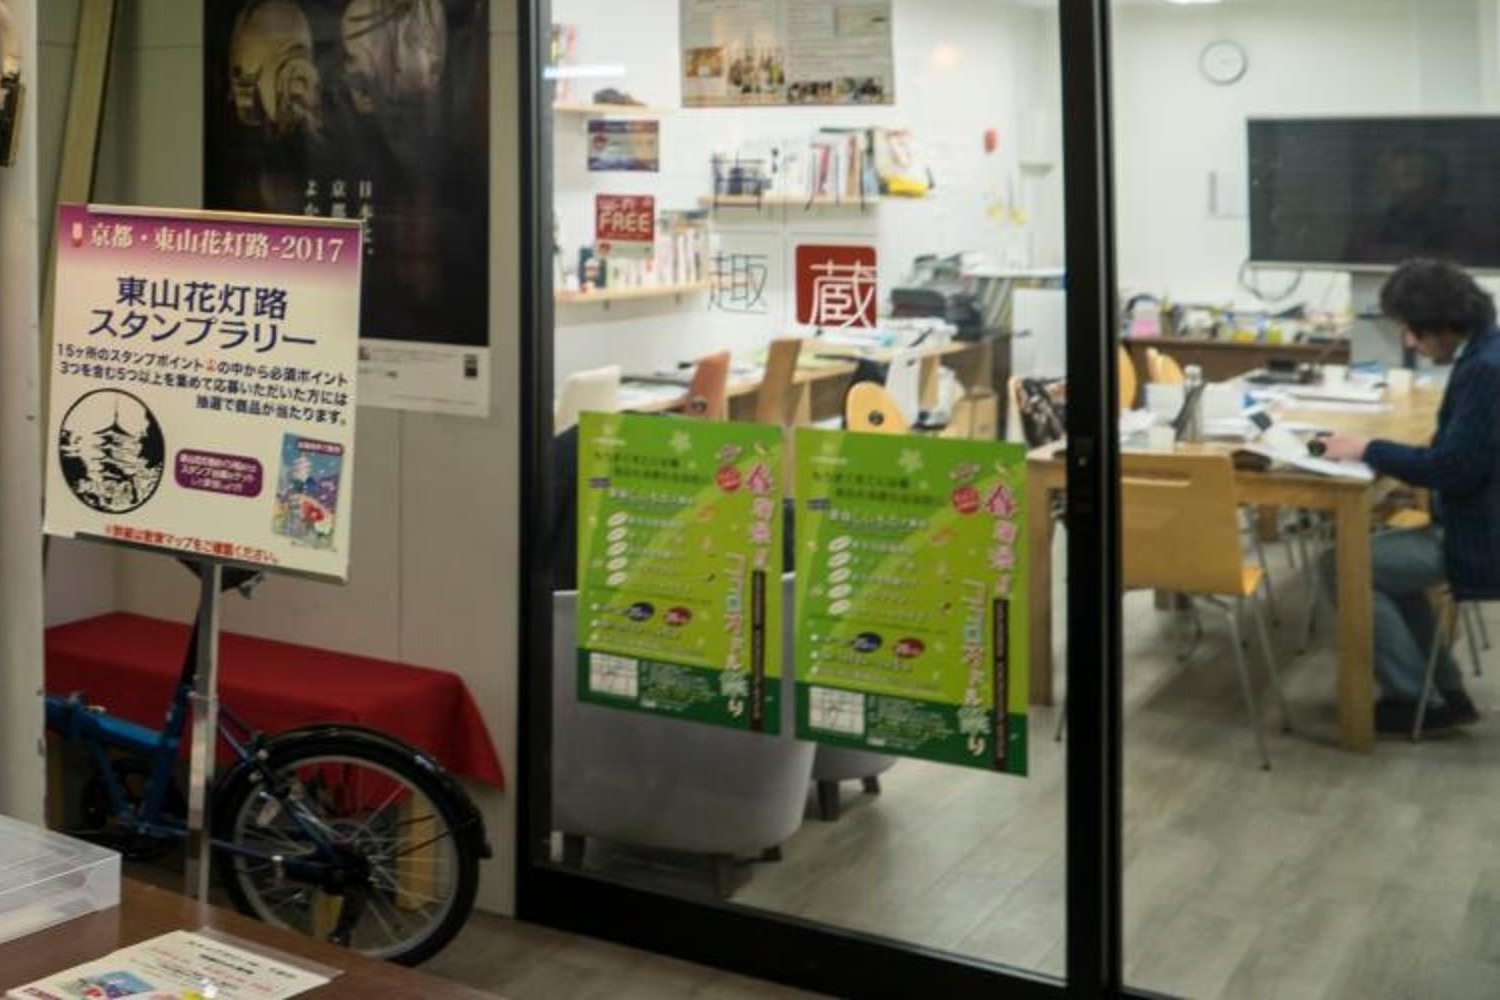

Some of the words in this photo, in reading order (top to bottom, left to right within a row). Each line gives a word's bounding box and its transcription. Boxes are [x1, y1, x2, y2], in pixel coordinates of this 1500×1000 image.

[115, 275, 288, 321] 東山花灯路
[88, 309, 317, 353] スタンプラリー
